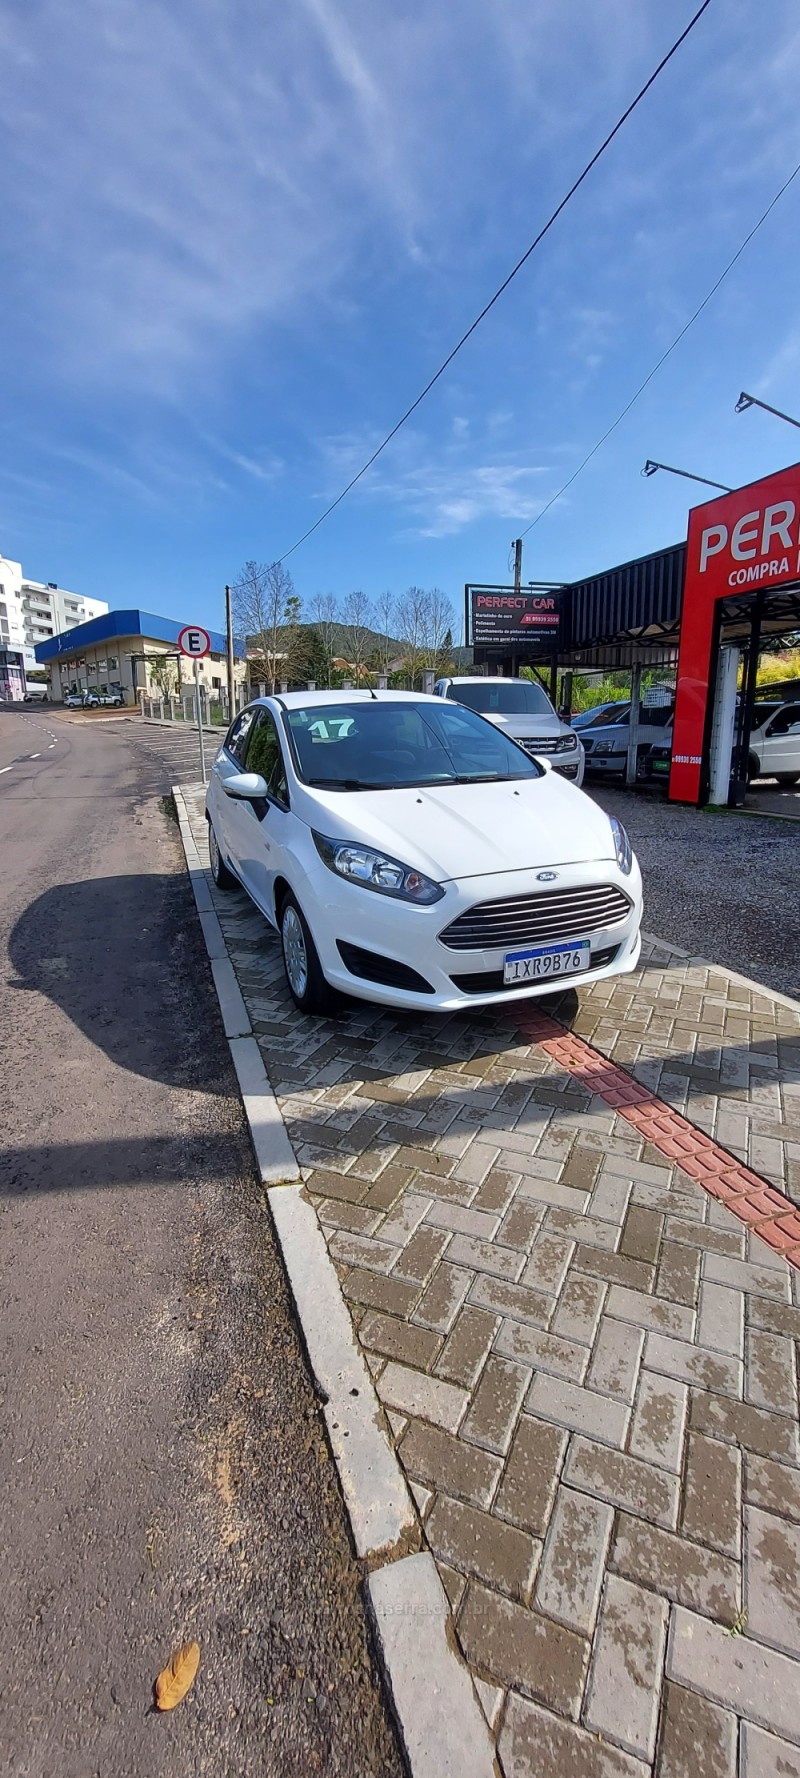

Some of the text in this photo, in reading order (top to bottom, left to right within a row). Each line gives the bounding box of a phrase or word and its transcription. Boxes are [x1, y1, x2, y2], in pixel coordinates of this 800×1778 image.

[699, 500, 800, 573] PER
[728, 557, 789, 586] COMPRA
[477, 595, 555, 609] PERFECT CAR
[188, 632, 201, 651] E
[307, 718, 355, 739] 17
[539, 872, 556, 880] Ford
[512, 951, 581, 979] IXR9B76
